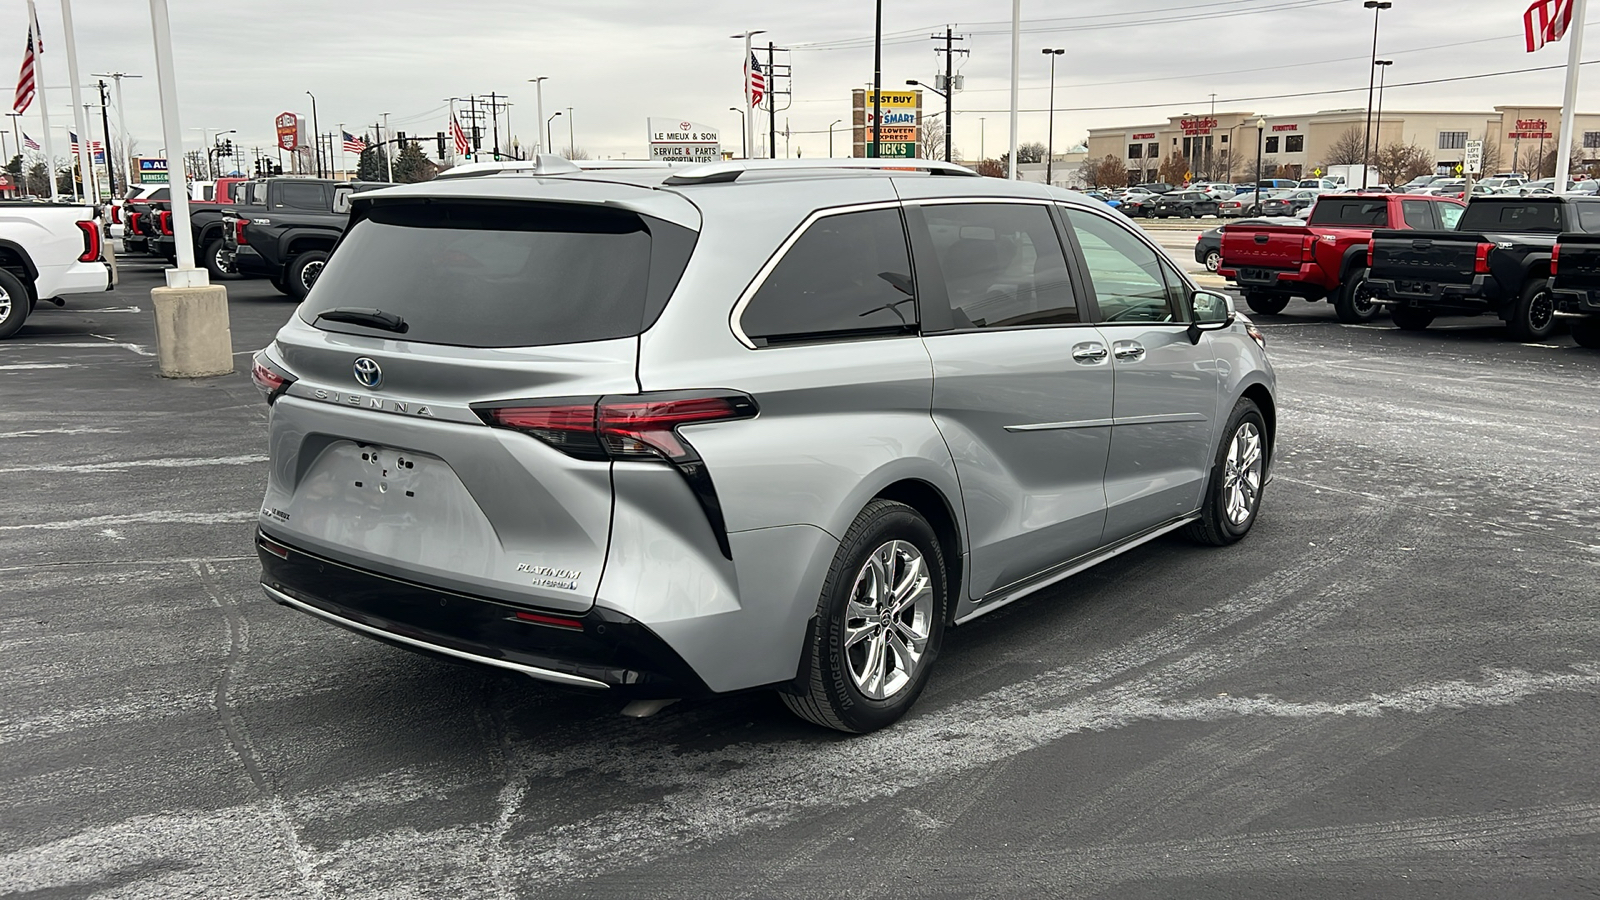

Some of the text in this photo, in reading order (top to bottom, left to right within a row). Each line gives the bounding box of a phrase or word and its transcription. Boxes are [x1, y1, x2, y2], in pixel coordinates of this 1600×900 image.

[867, 113, 914, 124] PTSMART
[654, 132, 717, 140] LE MIEUX & SON
[653, 147, 717, 156] SERVICE & PARTS
[153, 161, 168, 169] AL
[1235, 249, 1289, 257] TACOMA
[1387, 258, 1457, 268] TACOMA
[315, 389, 434, 417] SIENNA
[516, 562, 581, 580] PLATINUM
[532, 577, 570, 589] HYBRID
[829, 614, 854, 710] BRIDGESTONE
